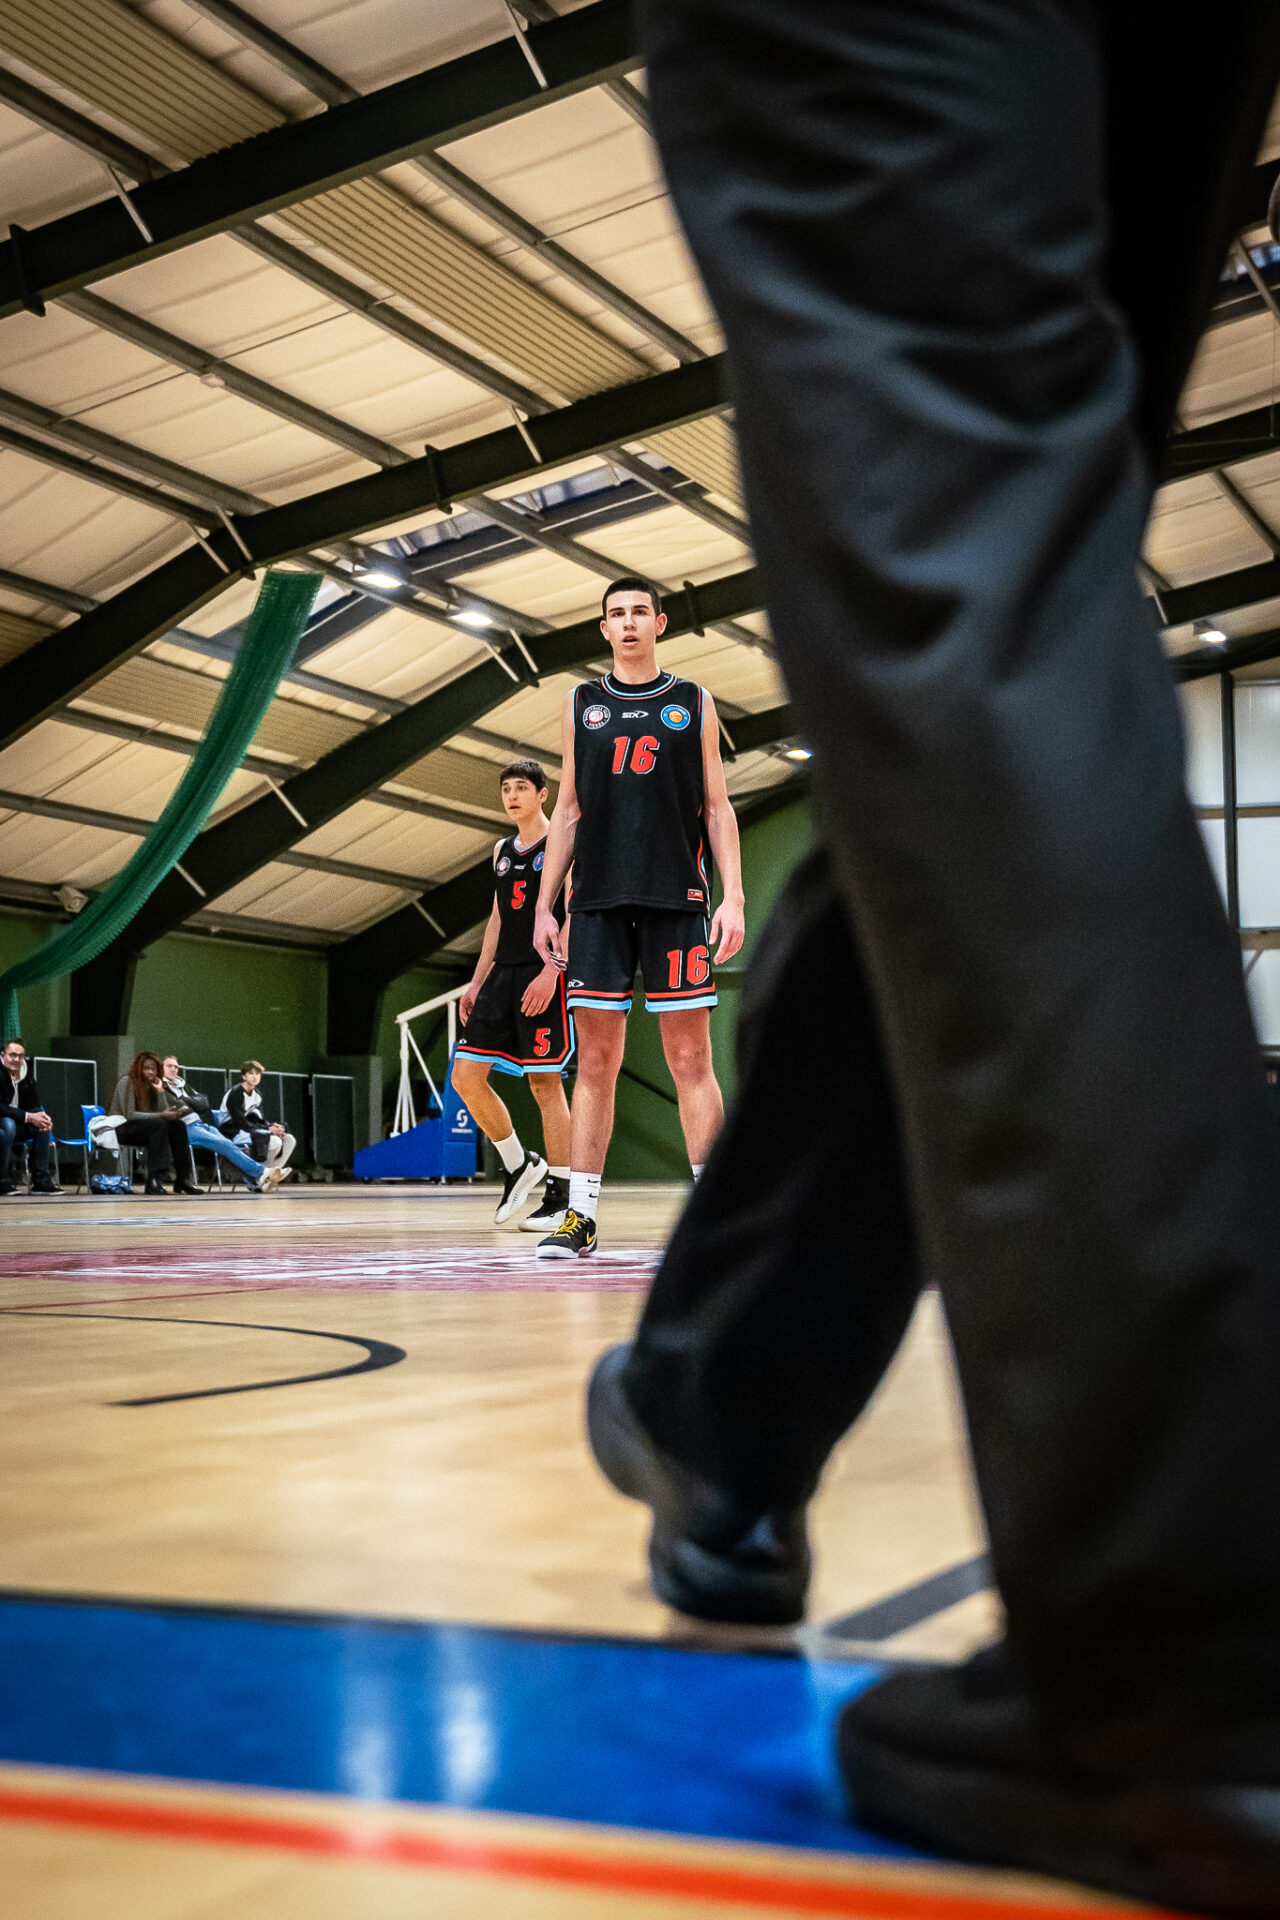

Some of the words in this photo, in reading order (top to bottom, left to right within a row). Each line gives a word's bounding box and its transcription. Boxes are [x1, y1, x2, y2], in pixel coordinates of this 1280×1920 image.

[612, 735, 660, 775] 16
[511, 880, 527, 910] 5
[667, 944, 710, 989] 16
[533, 1027, 551, 1057] 5
